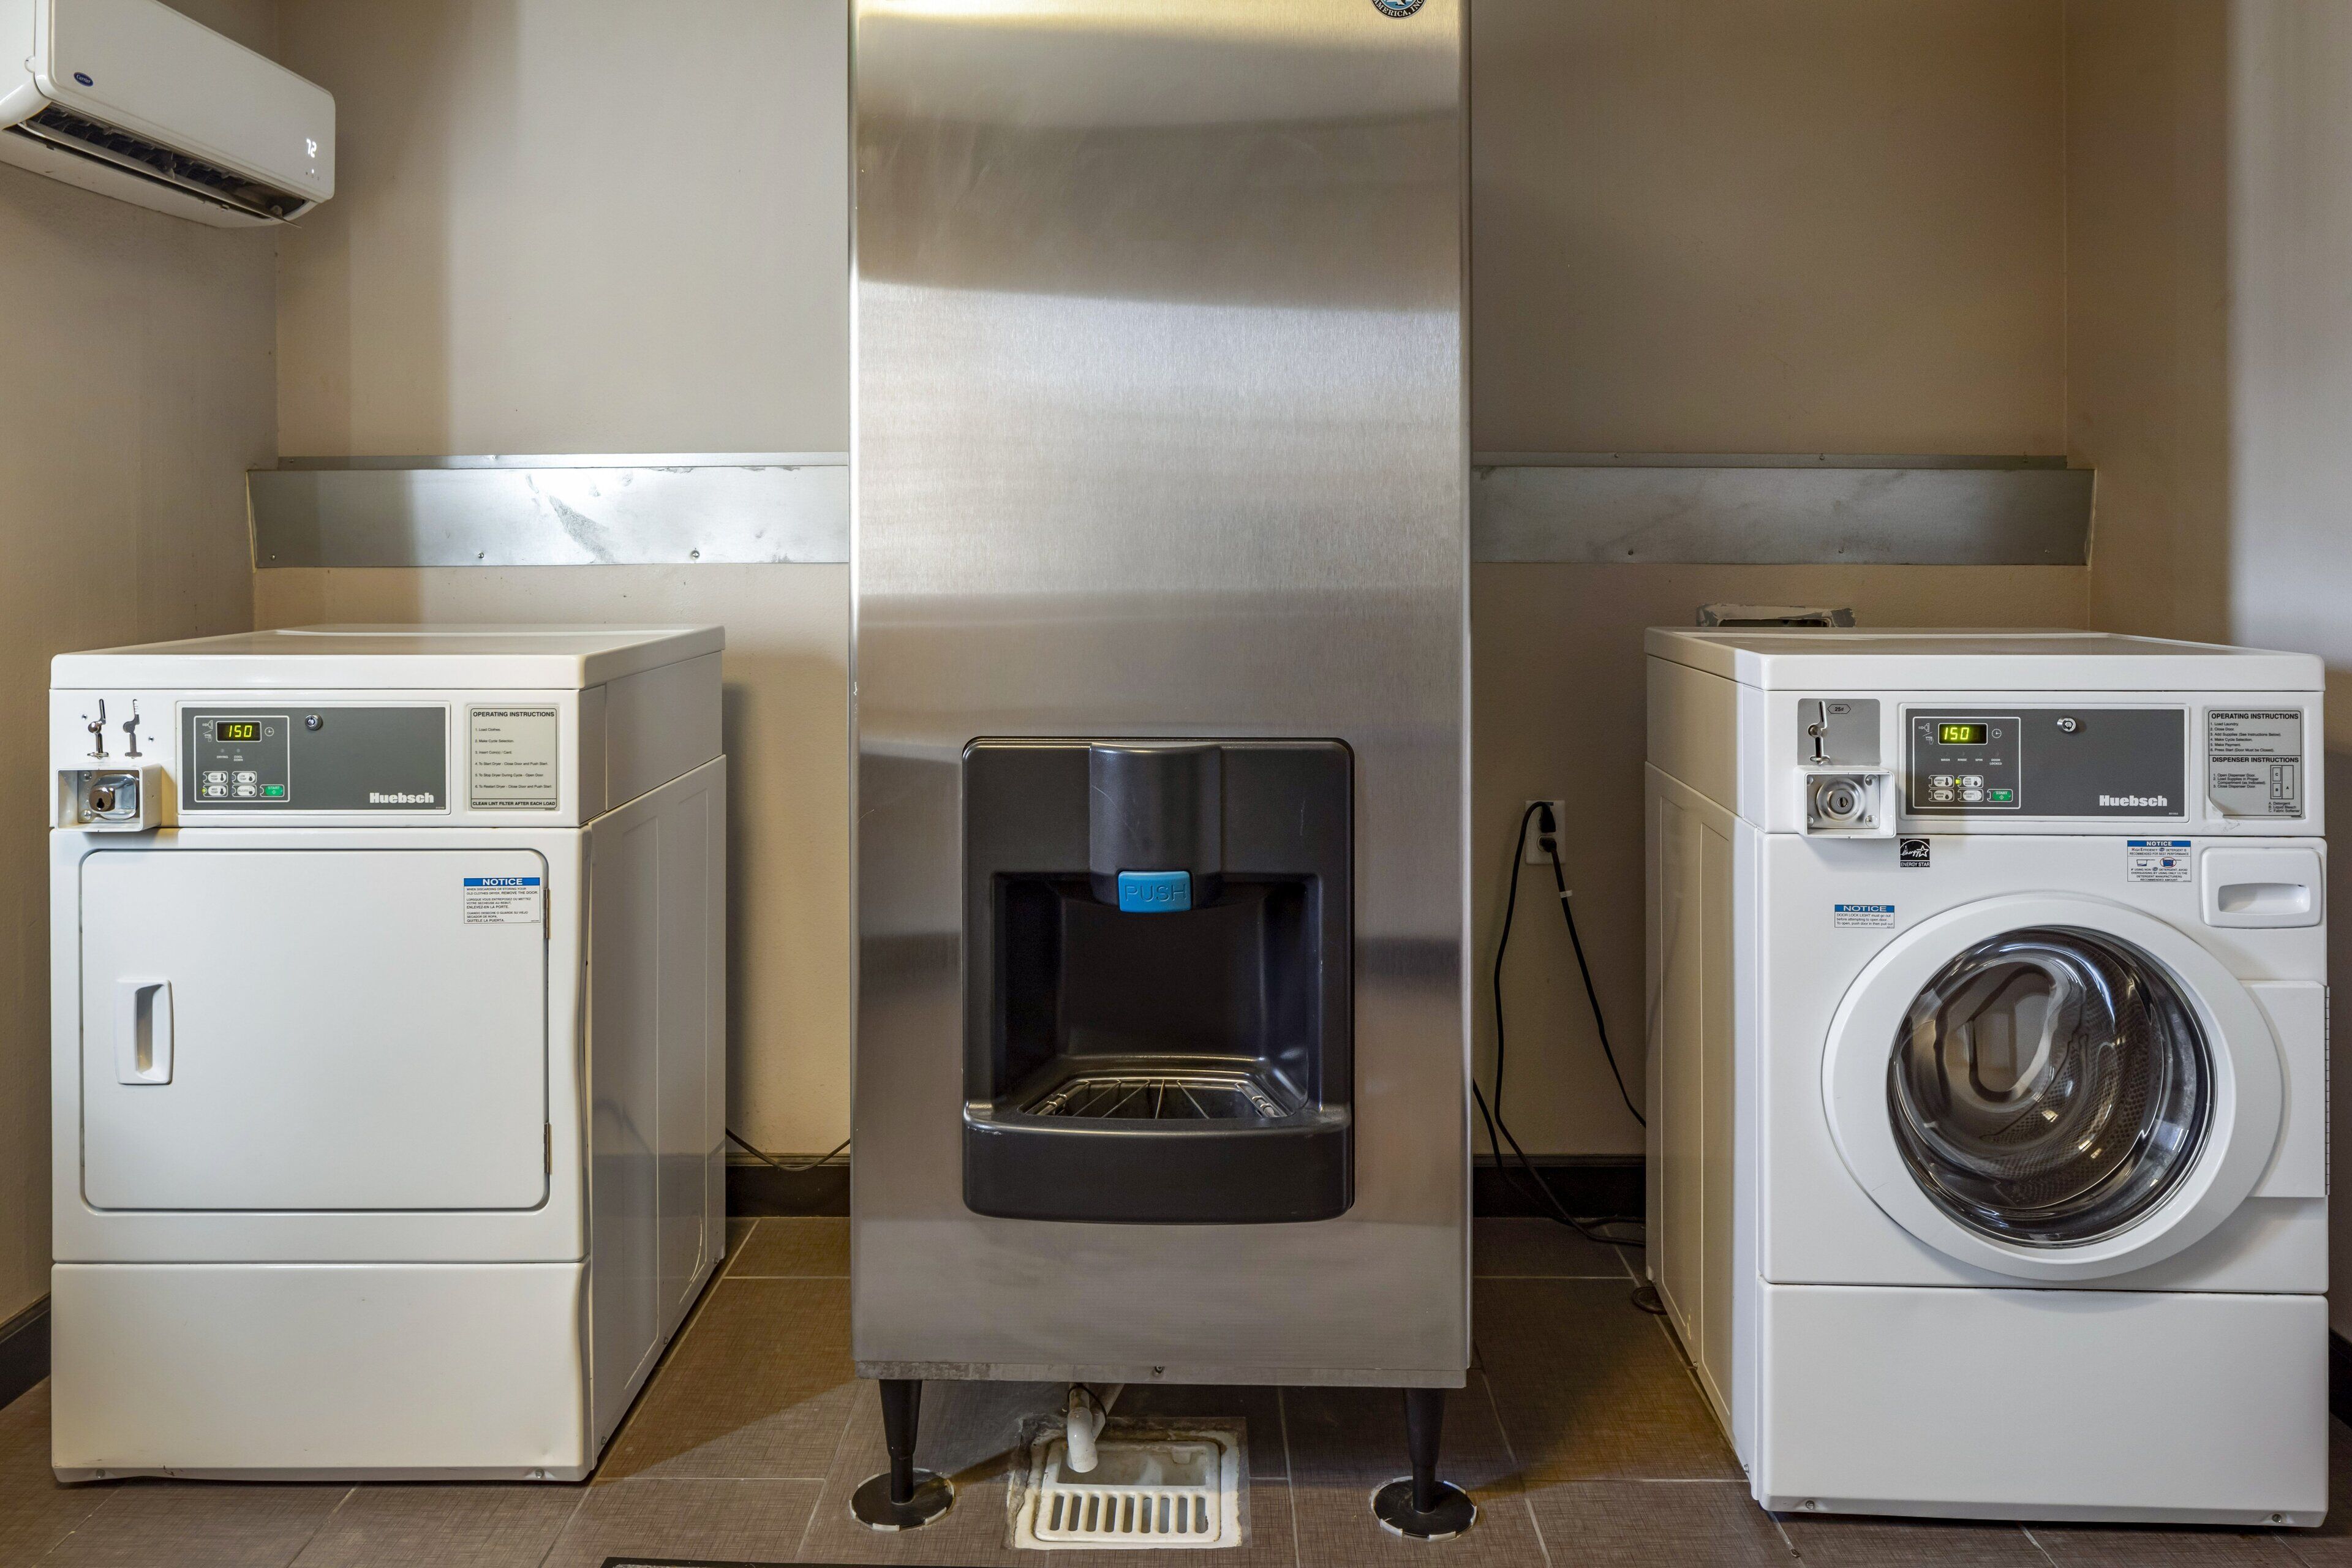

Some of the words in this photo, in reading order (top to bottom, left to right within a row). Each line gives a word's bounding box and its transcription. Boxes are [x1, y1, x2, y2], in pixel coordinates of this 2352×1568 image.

[76, 74, 91, 83] Carrier
[306, 138, 317, 158] 72
[228, 725, 252, 737] 150
[1944, 727, 1969, 740] 150
[369, 792, 434, 803] Huebsch
[2099, 795, 2168, 807] Huebsch
[1125, 885, 1187, 902] PUSH
